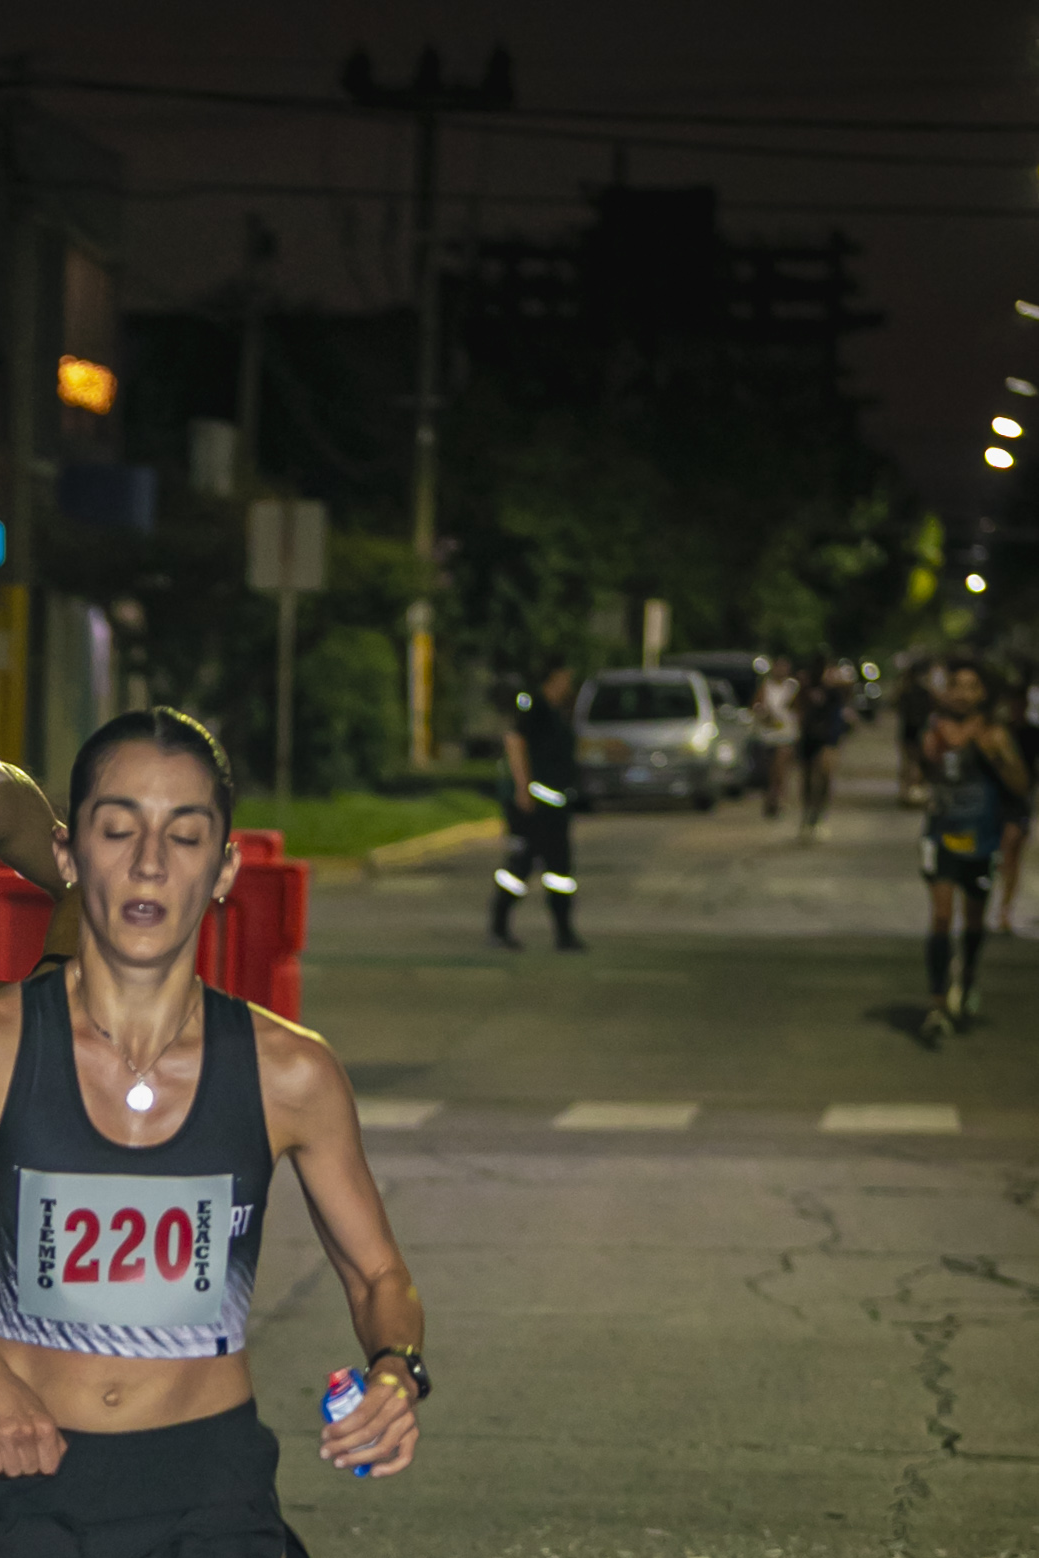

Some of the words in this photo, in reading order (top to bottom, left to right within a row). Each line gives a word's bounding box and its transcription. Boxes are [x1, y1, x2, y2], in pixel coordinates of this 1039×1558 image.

[37, 1198, 57, 1290] TIEMPO
[62, 1206, 193, 1284] 220
[194, 1200, 212, 1292] EXACTO
